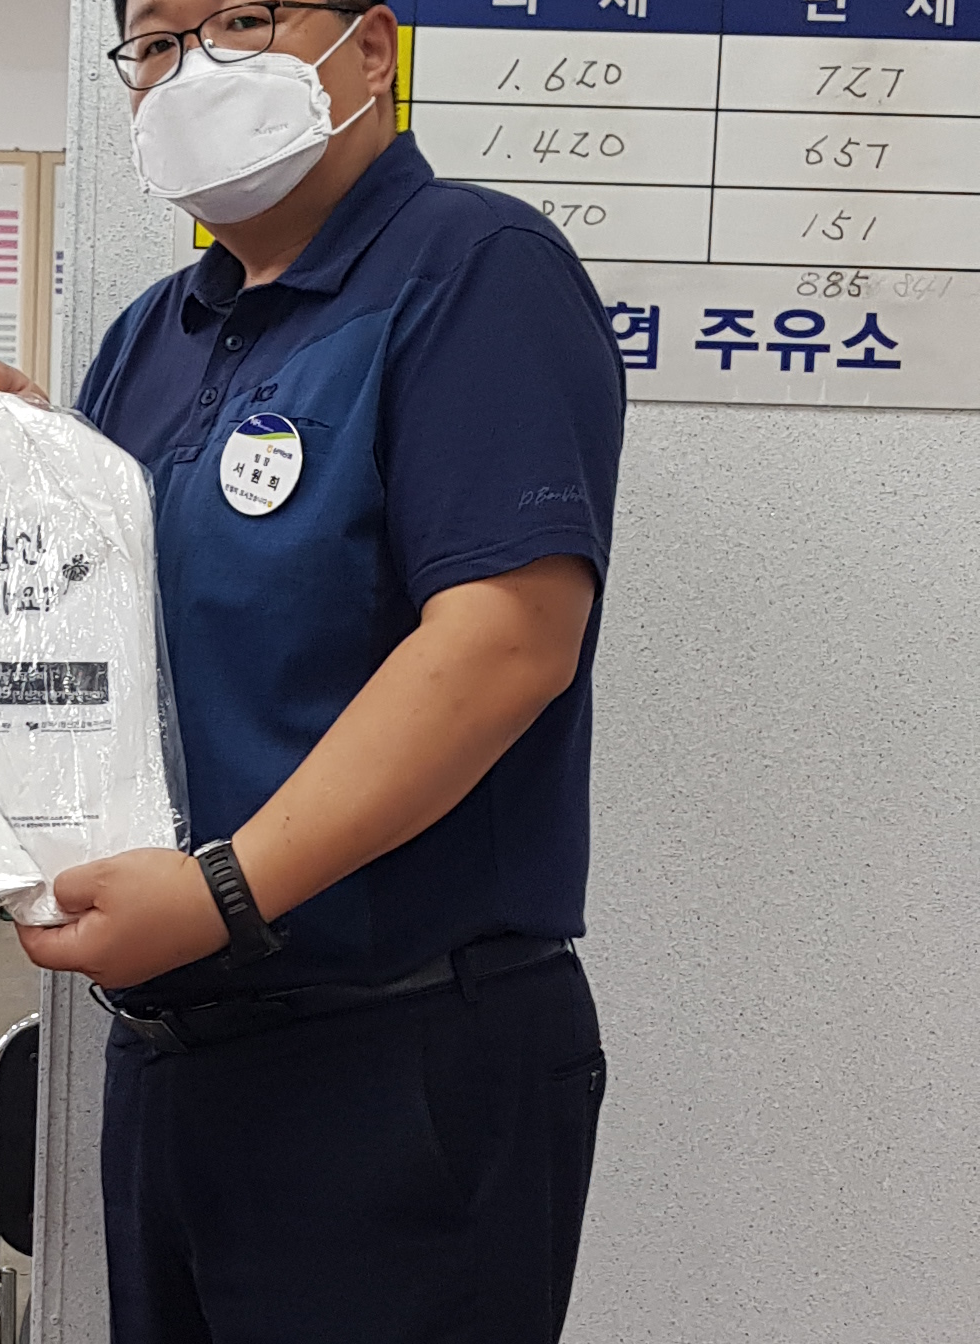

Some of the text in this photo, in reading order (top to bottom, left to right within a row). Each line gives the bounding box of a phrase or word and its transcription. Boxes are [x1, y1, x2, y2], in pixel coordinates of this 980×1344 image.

[815, 65, 906, 99] 727
[804, 135, 890, 169] 657
[801, 210, 877, 242] 151
[694, 308, 902, 373] 주유소
